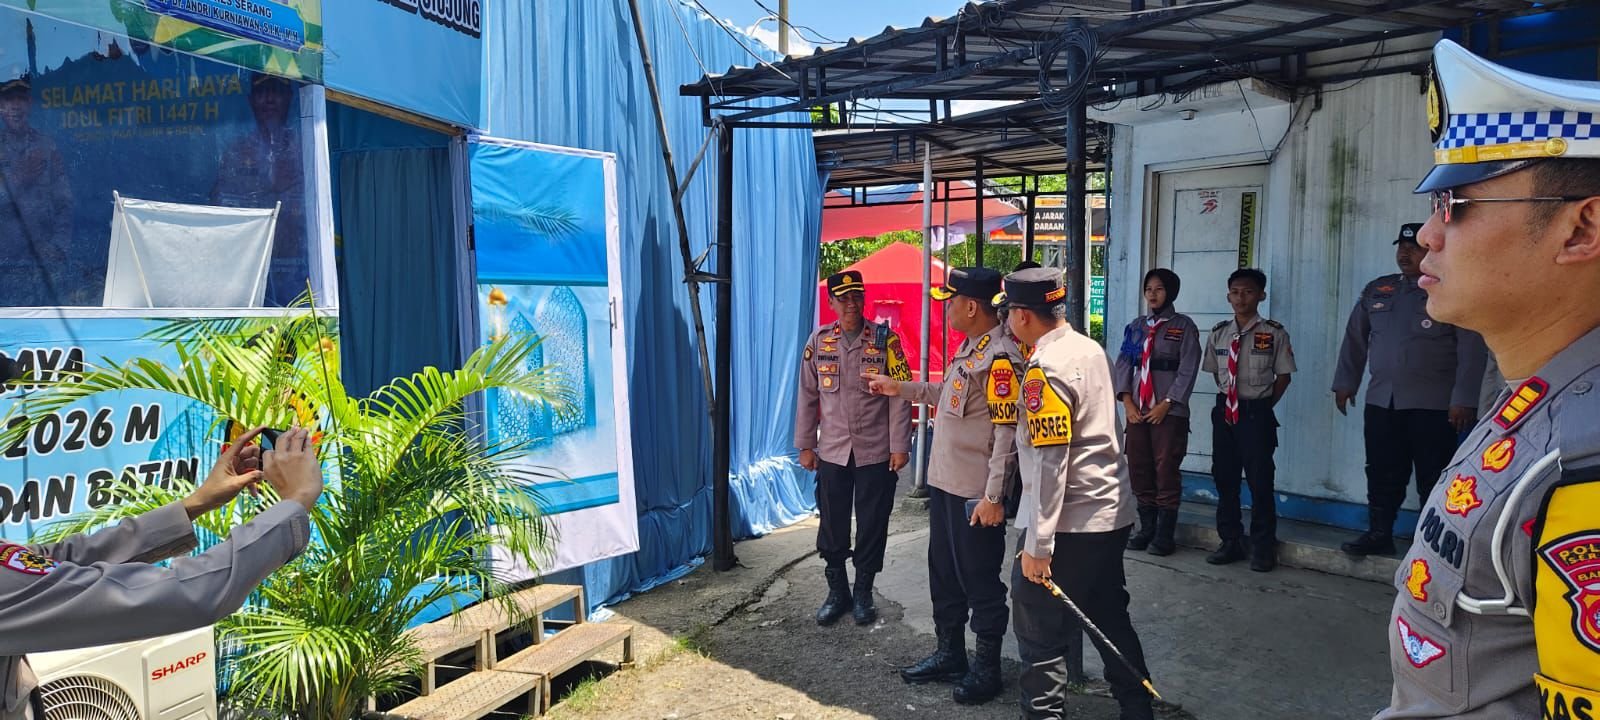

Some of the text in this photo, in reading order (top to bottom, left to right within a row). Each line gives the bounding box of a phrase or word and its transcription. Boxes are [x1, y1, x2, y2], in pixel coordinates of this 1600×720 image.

[186, 0, 211, 16] ANDRI
[236, 0, 272, 18] SERANG
[41, 73, 243, 110] SELAMAT HARI RAYA
[62, 102, 220, 130] IDUL FITRI 1447 H
[1034, 223, 1065, 231] DARAAN
[1042, 212, 1065, 220] JARAK
[0, 347, 84, 394] AYA
[4, 404, 161, 458] 2026 M
[87, 457, 200, 511] BATIN
[1420, 506, 1465, 570] POLRI
[151, 652, 207, 681] SHARP
